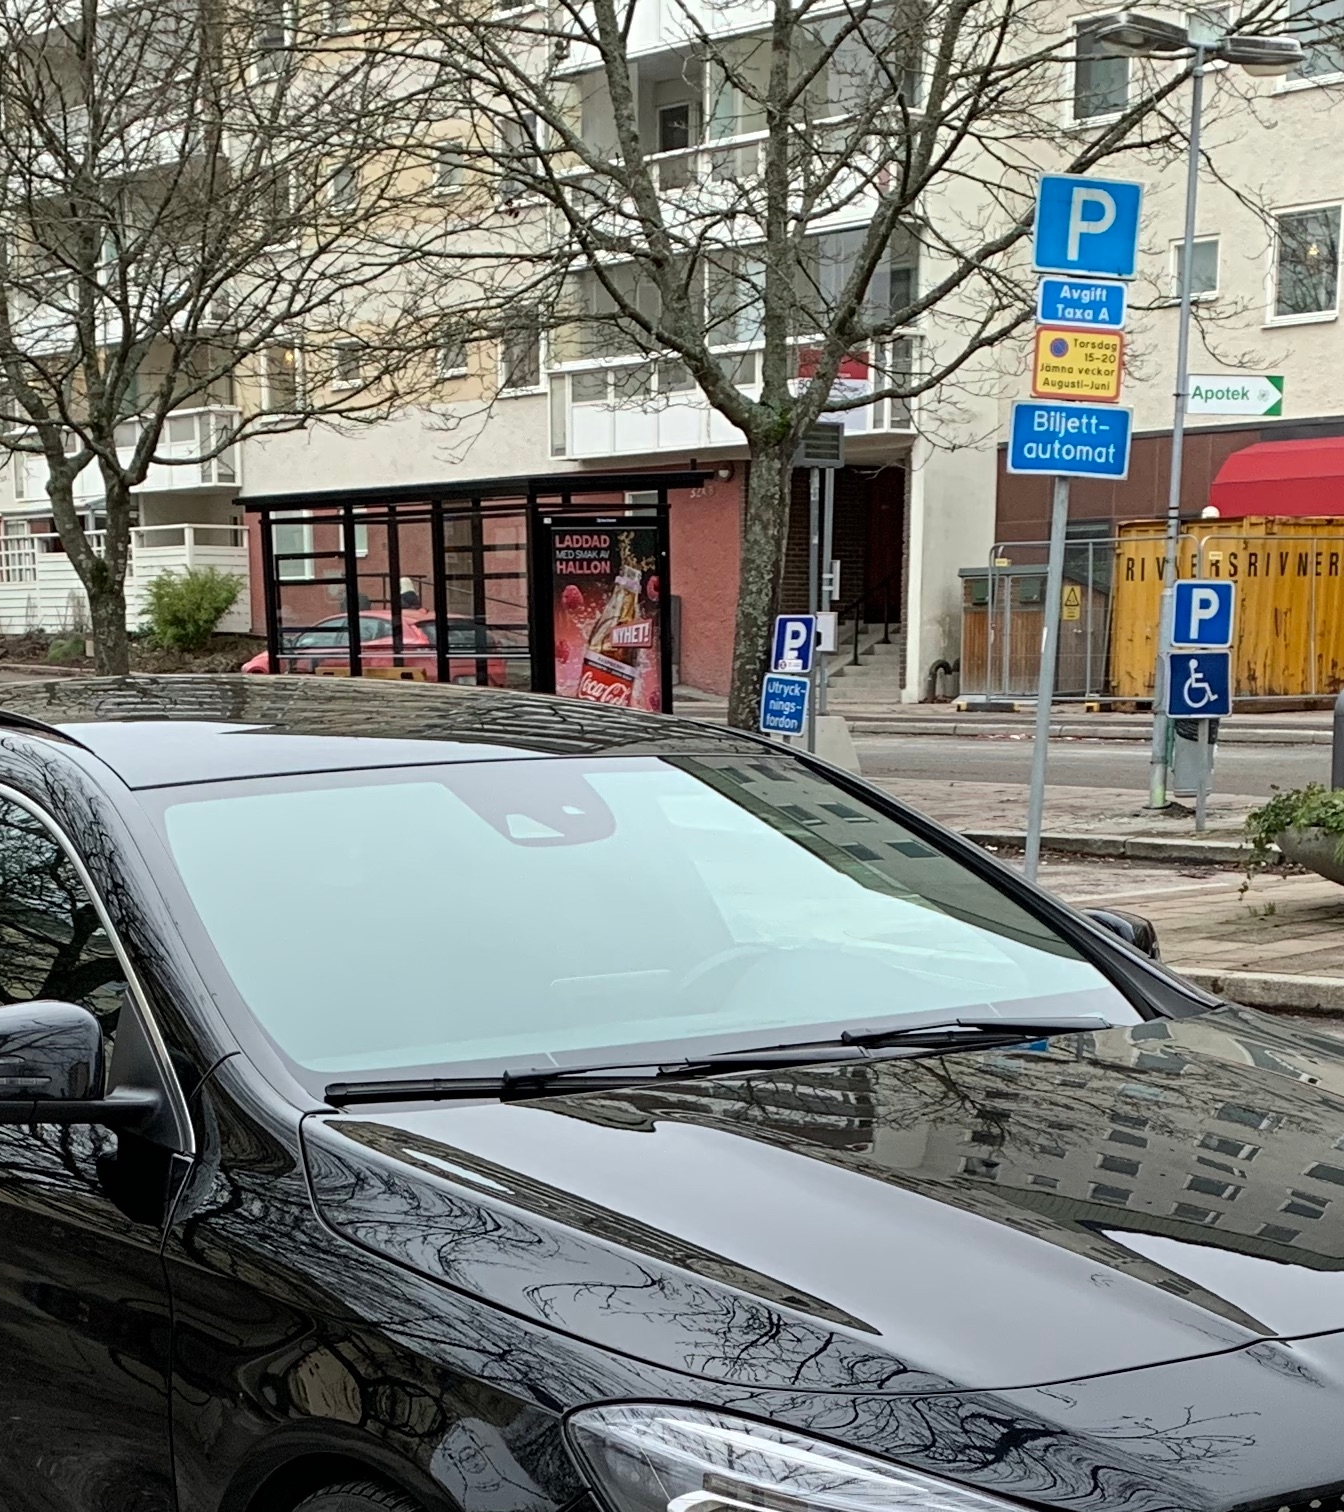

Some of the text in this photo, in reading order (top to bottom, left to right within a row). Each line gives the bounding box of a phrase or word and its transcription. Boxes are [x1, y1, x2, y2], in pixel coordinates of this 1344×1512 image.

[1066, 186, 1118, 262] P
[1059, 285, 1108, 304] Avgift
[1056, 304, 1110, 321] Taxa A
[1073, 338, 1118, 352] Torsdag
[1084, 353, 1117, 364] 15-20
[1040, 363, 1116, 377] Jämna veckor
[1042, 377, 1111, 390] Augusti-Juni
[1191, 385, 1250, 403] Apotek
[1033, 410, 1110, 438] Biljett-
[1023, 440, 1116, 464] automat
[555, 535, 610, 548] LADDAD
[556, 550, 610, 559] MED SMAK AV
[556, 561, 611, 574] HALLON
[1189, 587, 1220, 640] P
[612, 622, 650, 645] NYHET!
[782, 621, 807, 661] P
[767, 681, 806, 698] Utryck-
[768, 698, 802, 715] nings-
[765, 713, 798, 729] fordon
